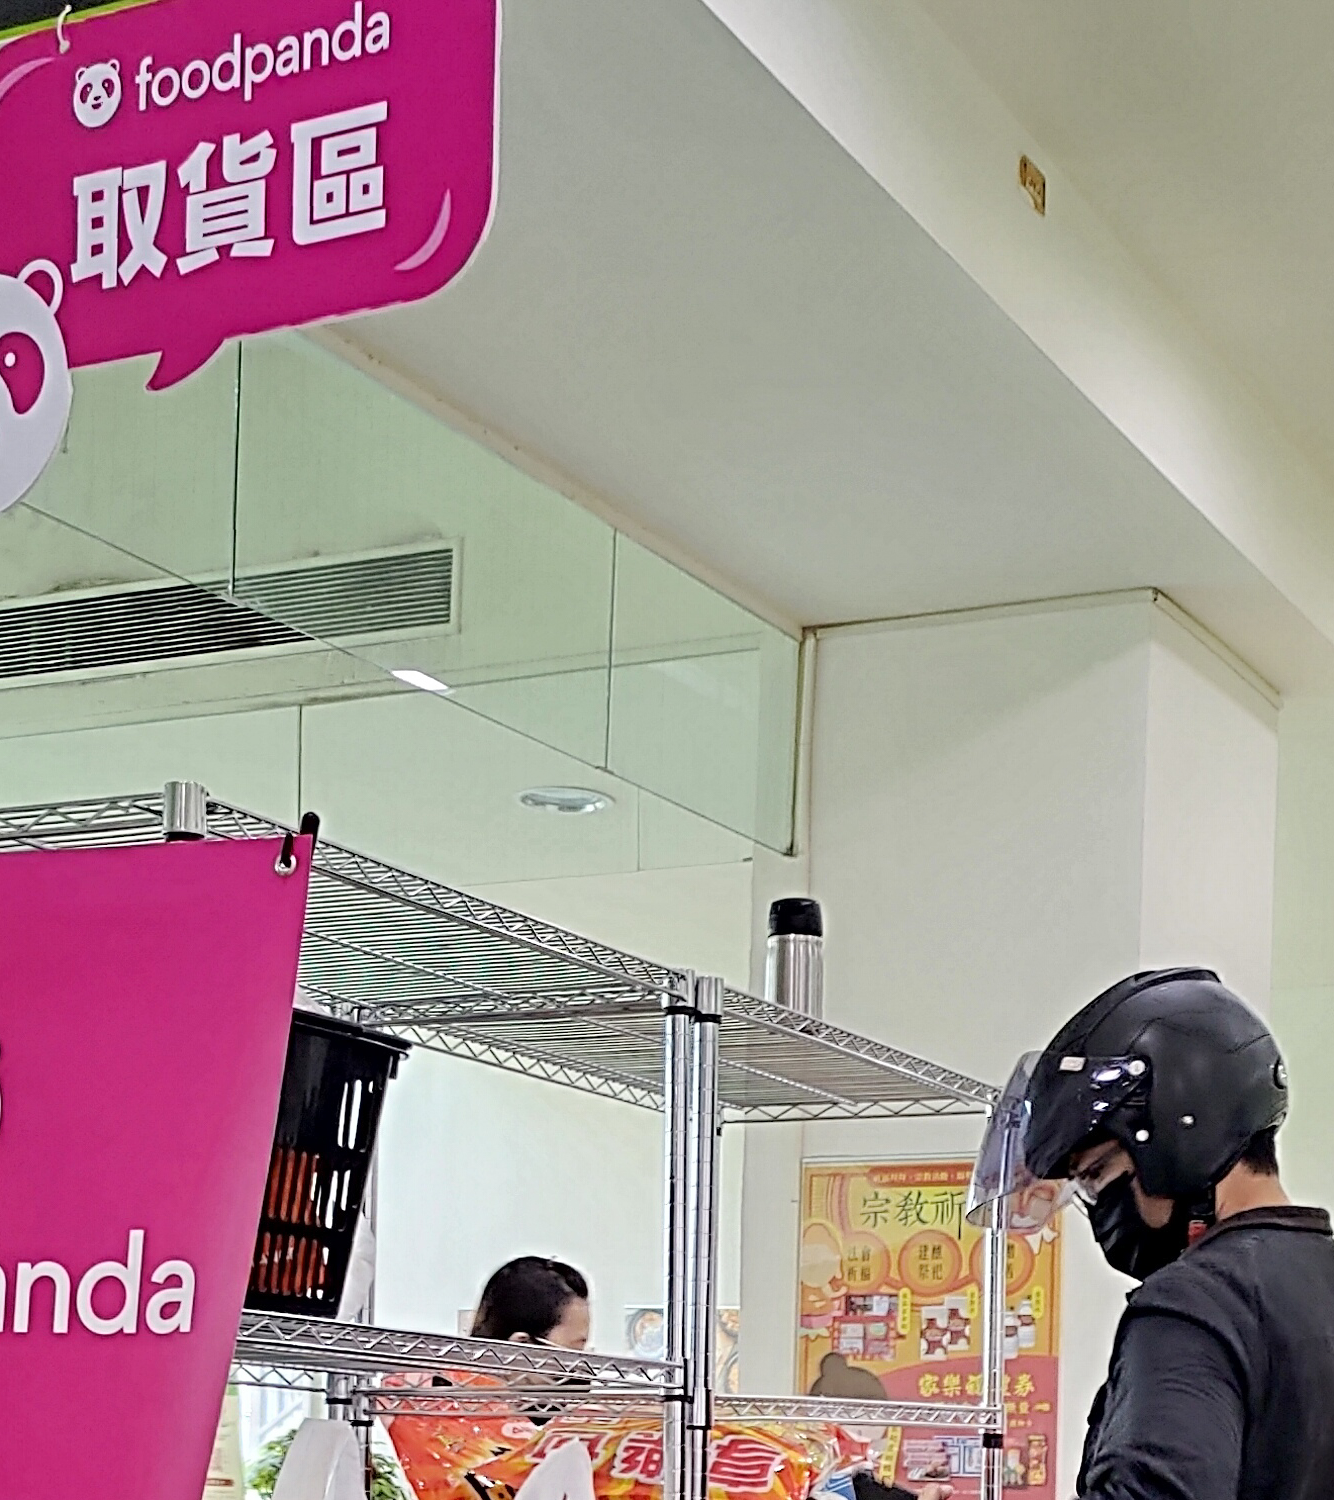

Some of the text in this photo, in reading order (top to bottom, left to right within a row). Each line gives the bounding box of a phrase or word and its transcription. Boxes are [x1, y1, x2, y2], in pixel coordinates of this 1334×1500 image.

[135, 0, 391, 111] foodpanda
[70, 100, 388, 289] 取貨區
